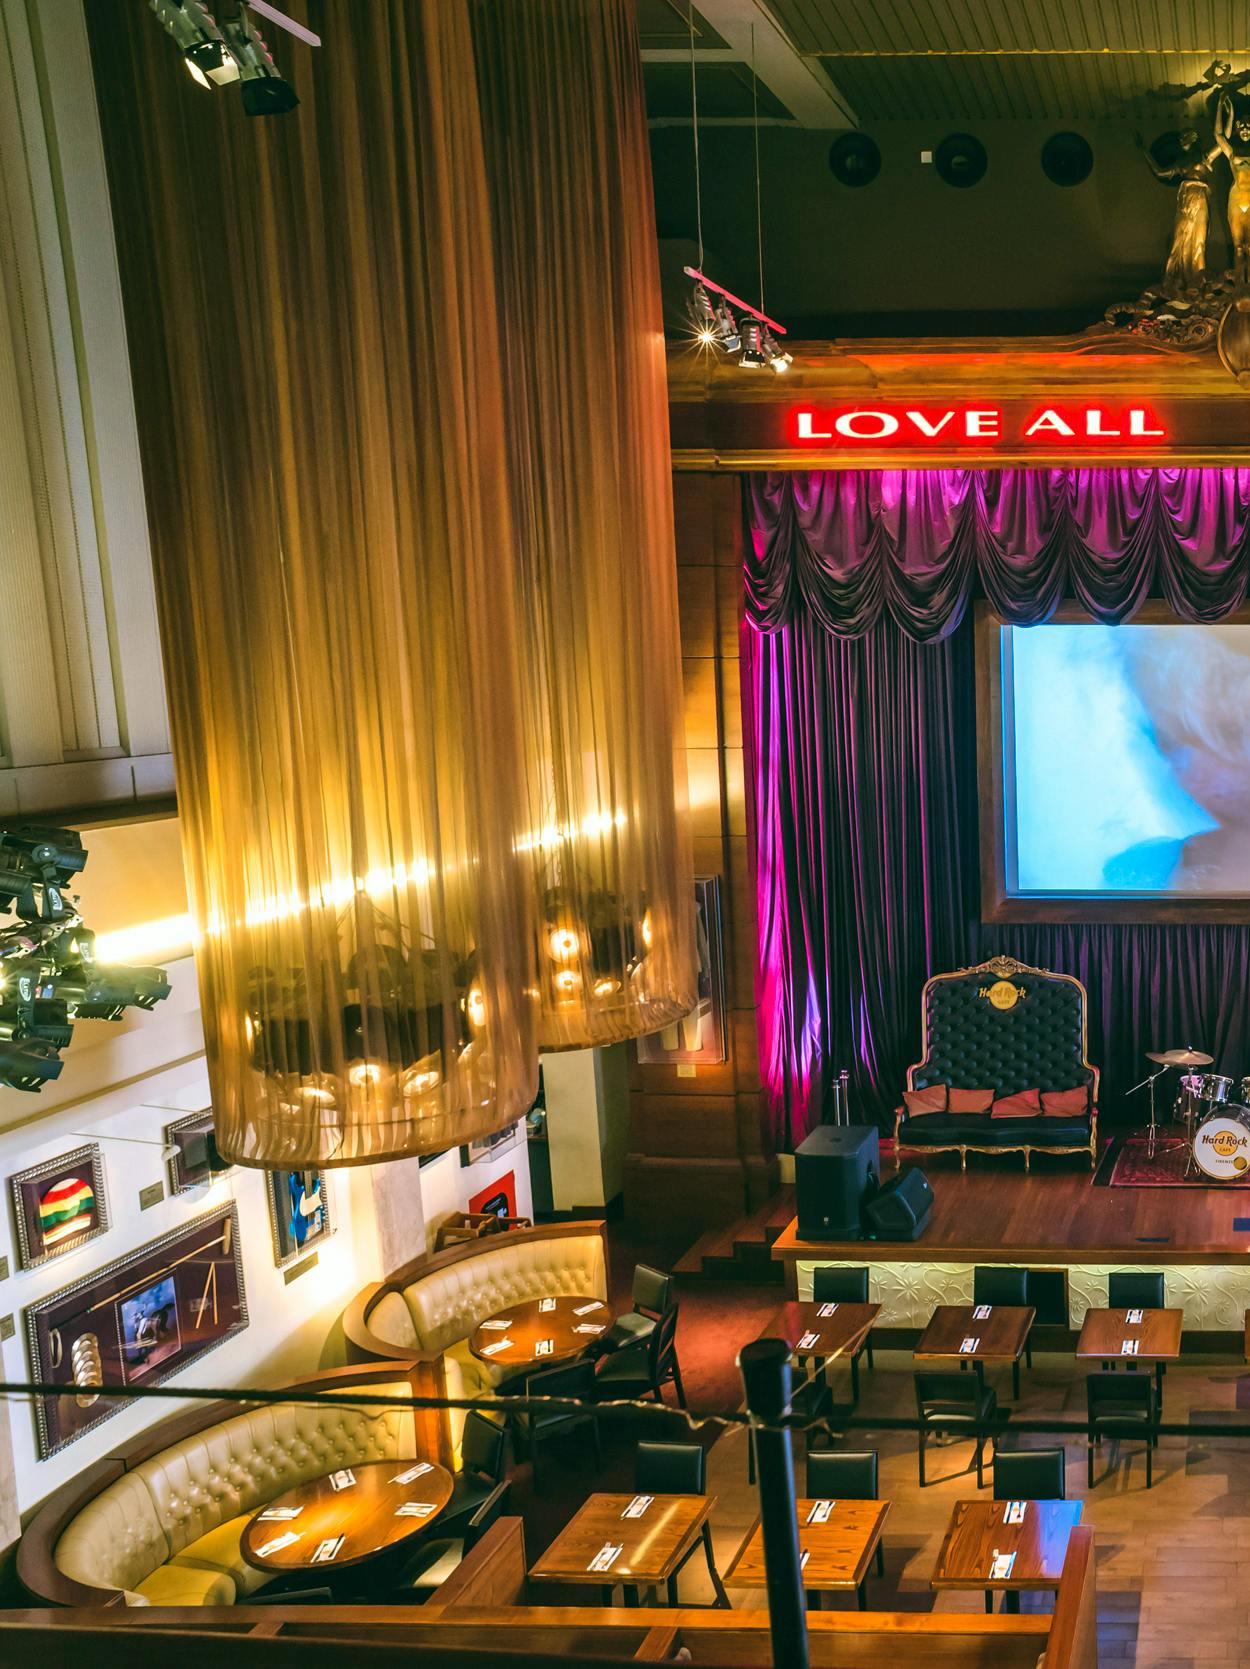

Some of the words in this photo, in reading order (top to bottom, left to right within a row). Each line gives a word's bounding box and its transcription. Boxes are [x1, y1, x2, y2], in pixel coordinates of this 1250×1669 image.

[797, 410, 999, 439] LOVE
[1024, 409, 1165, 436] ALL
[978, 986, 1003, 998] Hard
[1201, 1134, 1226, 1145] Hard
[1226, 1136, 1248, 1147] Rock
